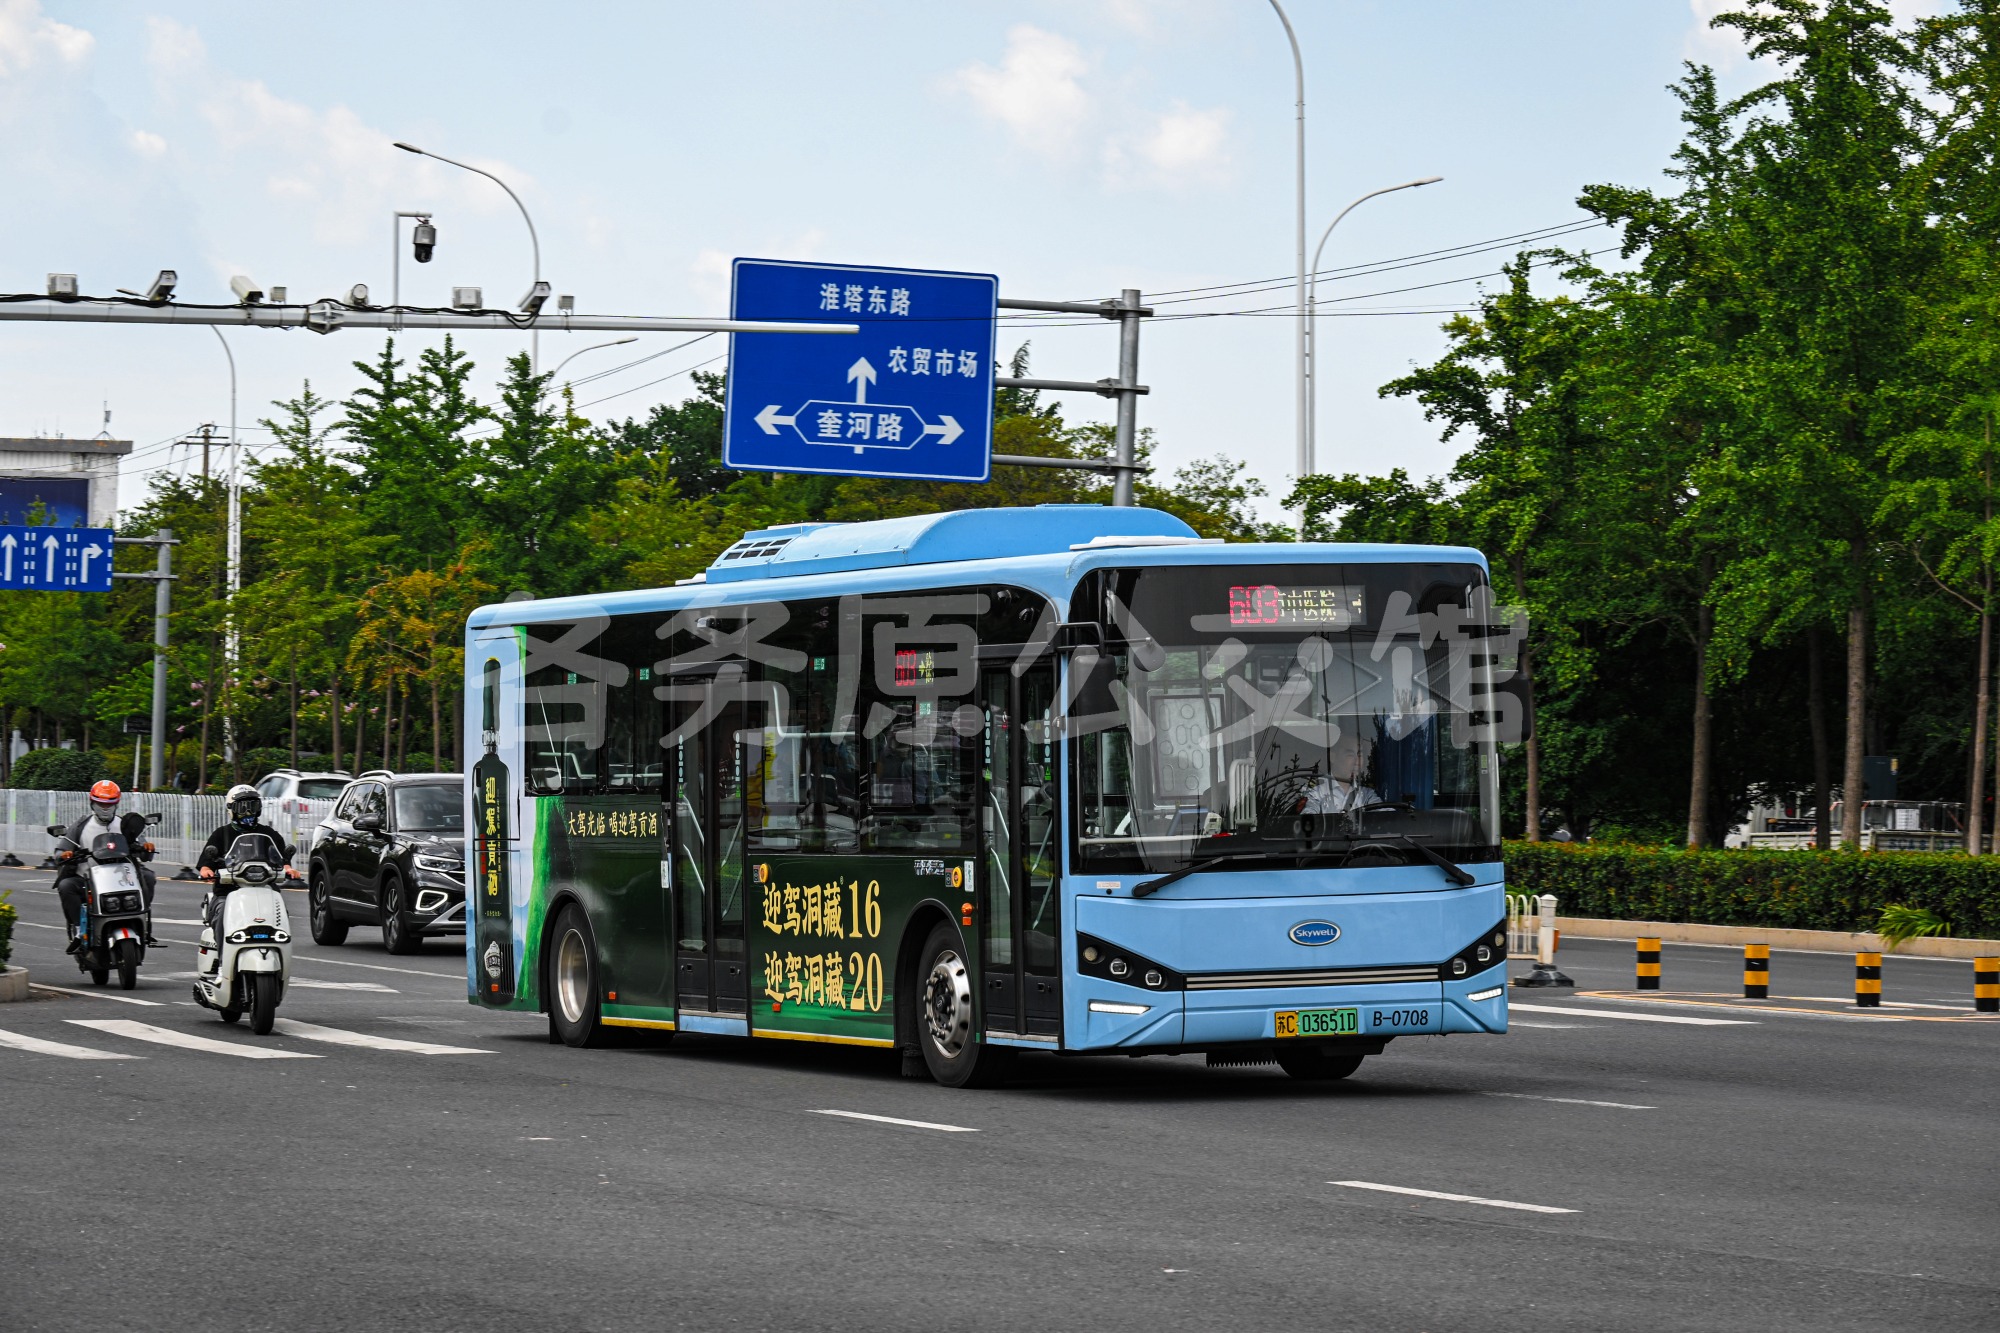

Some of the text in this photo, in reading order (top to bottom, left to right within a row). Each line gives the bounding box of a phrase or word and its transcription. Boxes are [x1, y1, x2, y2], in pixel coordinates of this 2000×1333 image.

[819, 283, 911, 316] 淮塔东路
[887, 346, 978, 378] 农贸市场
[816, 410, 904, 441] 奎河路
[1229, 585, 1279, 624] 603
[568, 809, 657, 837] 大驾光临 喝迎驾贡酒
[1372, 1010, 1429, 1027] B-0708
